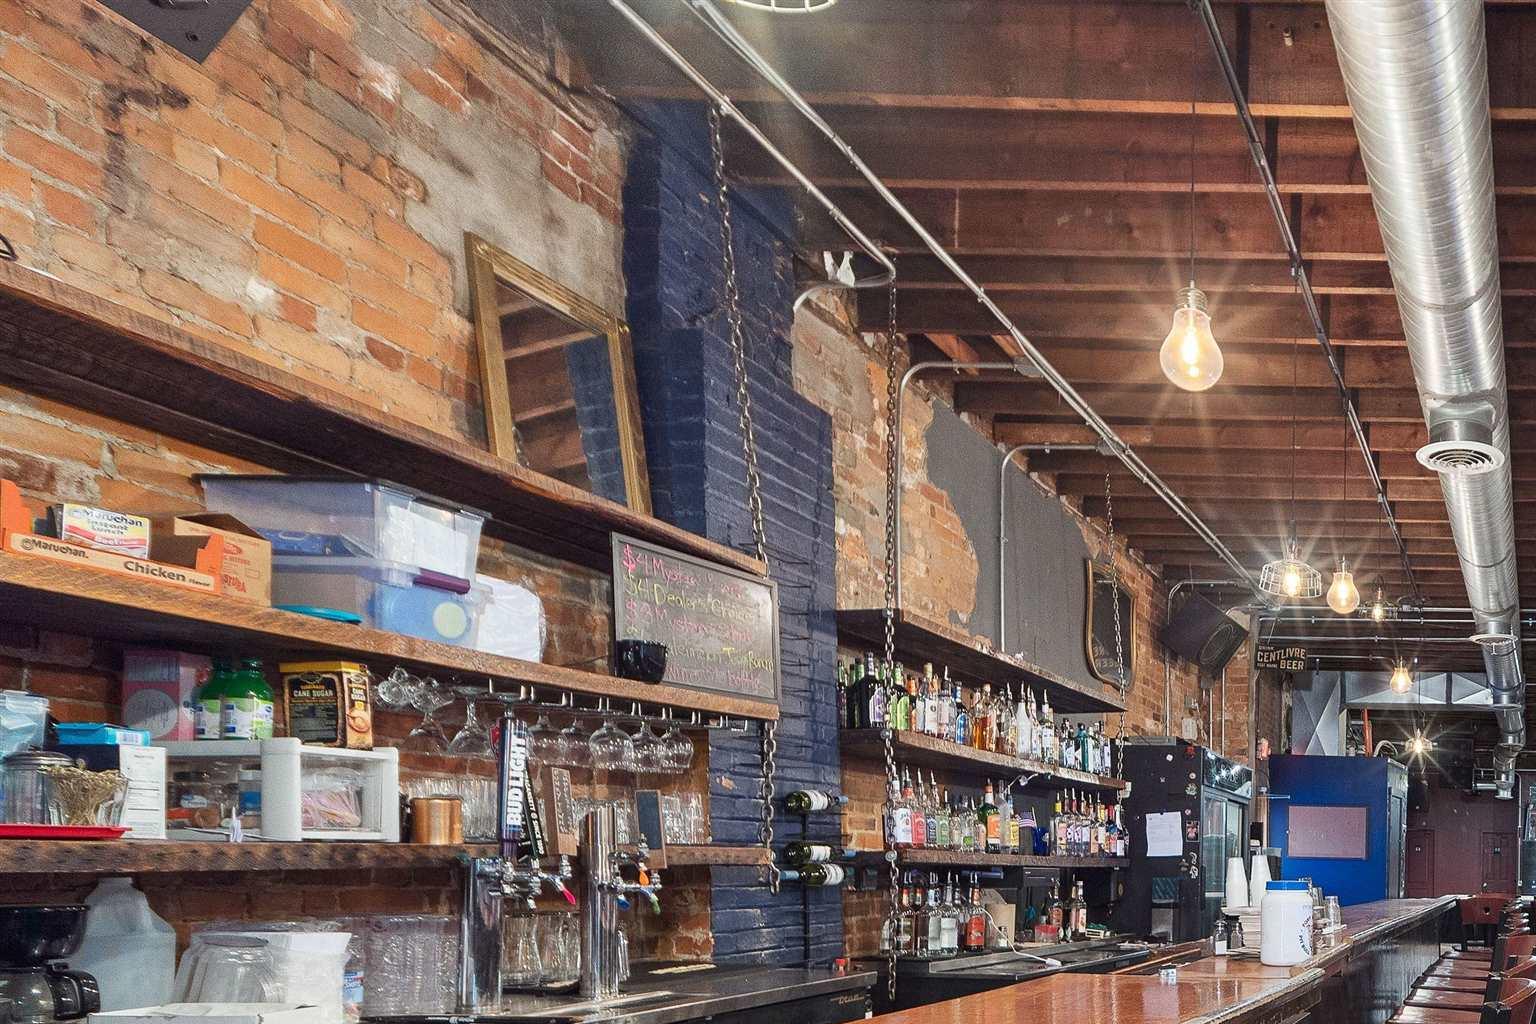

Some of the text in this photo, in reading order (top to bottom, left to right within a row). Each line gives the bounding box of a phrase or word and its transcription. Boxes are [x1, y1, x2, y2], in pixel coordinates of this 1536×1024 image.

[124, 561, 187, 582] Chicken
[1257, 647, 1306, 662] CENTLIVRE
[1280, 660, 1304, 670] BEER
[507, 738, 526, 825] BUD LIGHT
